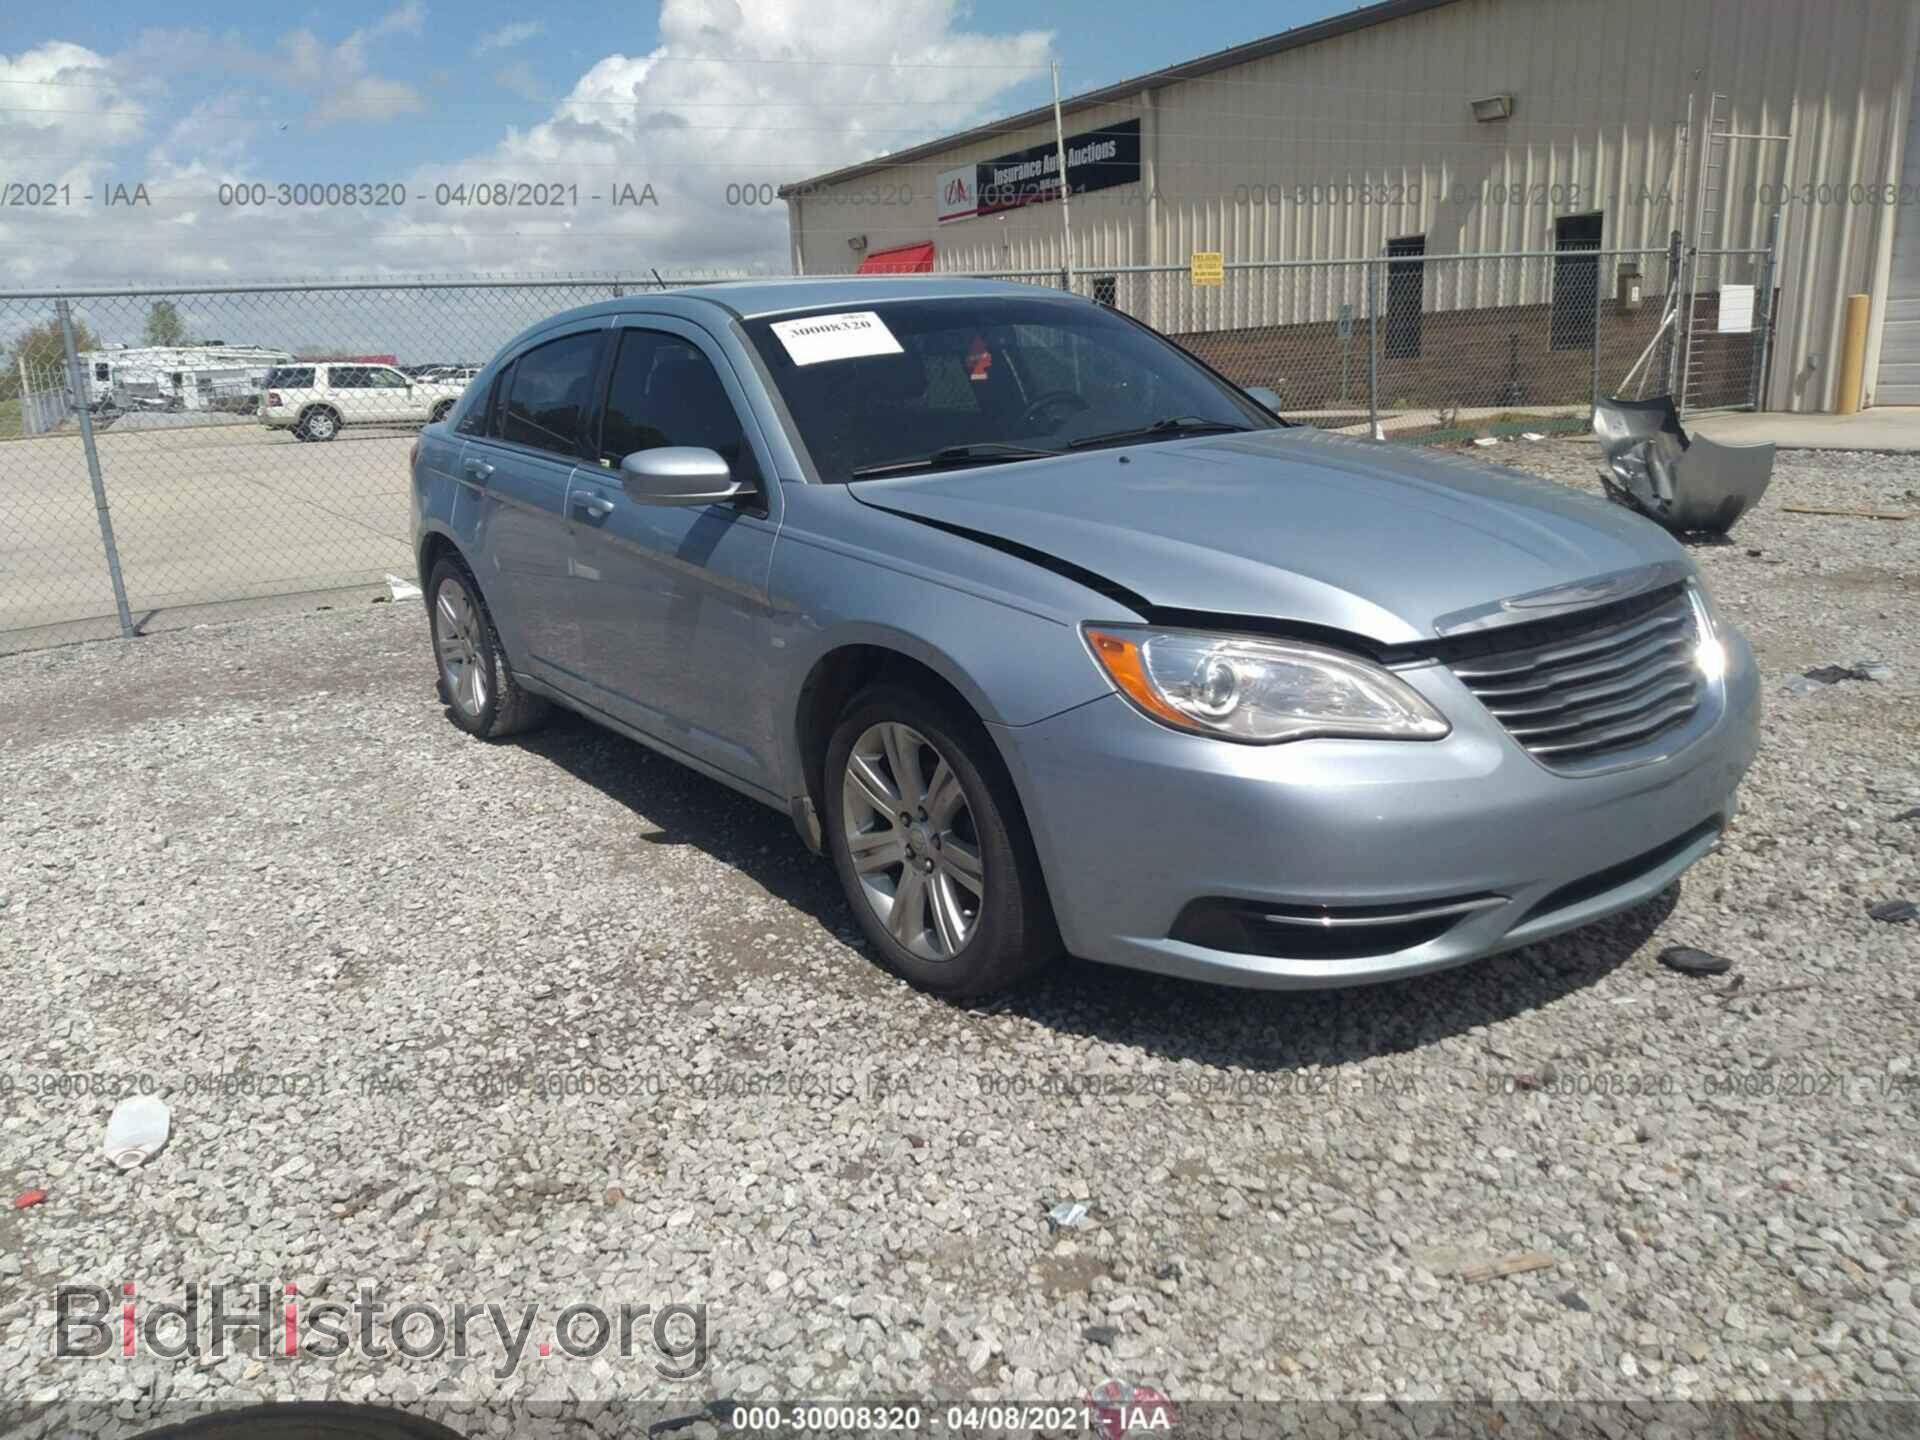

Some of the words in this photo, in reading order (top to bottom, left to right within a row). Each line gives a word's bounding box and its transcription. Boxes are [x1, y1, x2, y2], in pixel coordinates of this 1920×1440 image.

[994, 160, 1042, 186] Insurance
[1043, 153, 1066, 175] Aut
[1068, 139, 1117, 168] Auctions
[790, 321, 871, 338] 30008320
